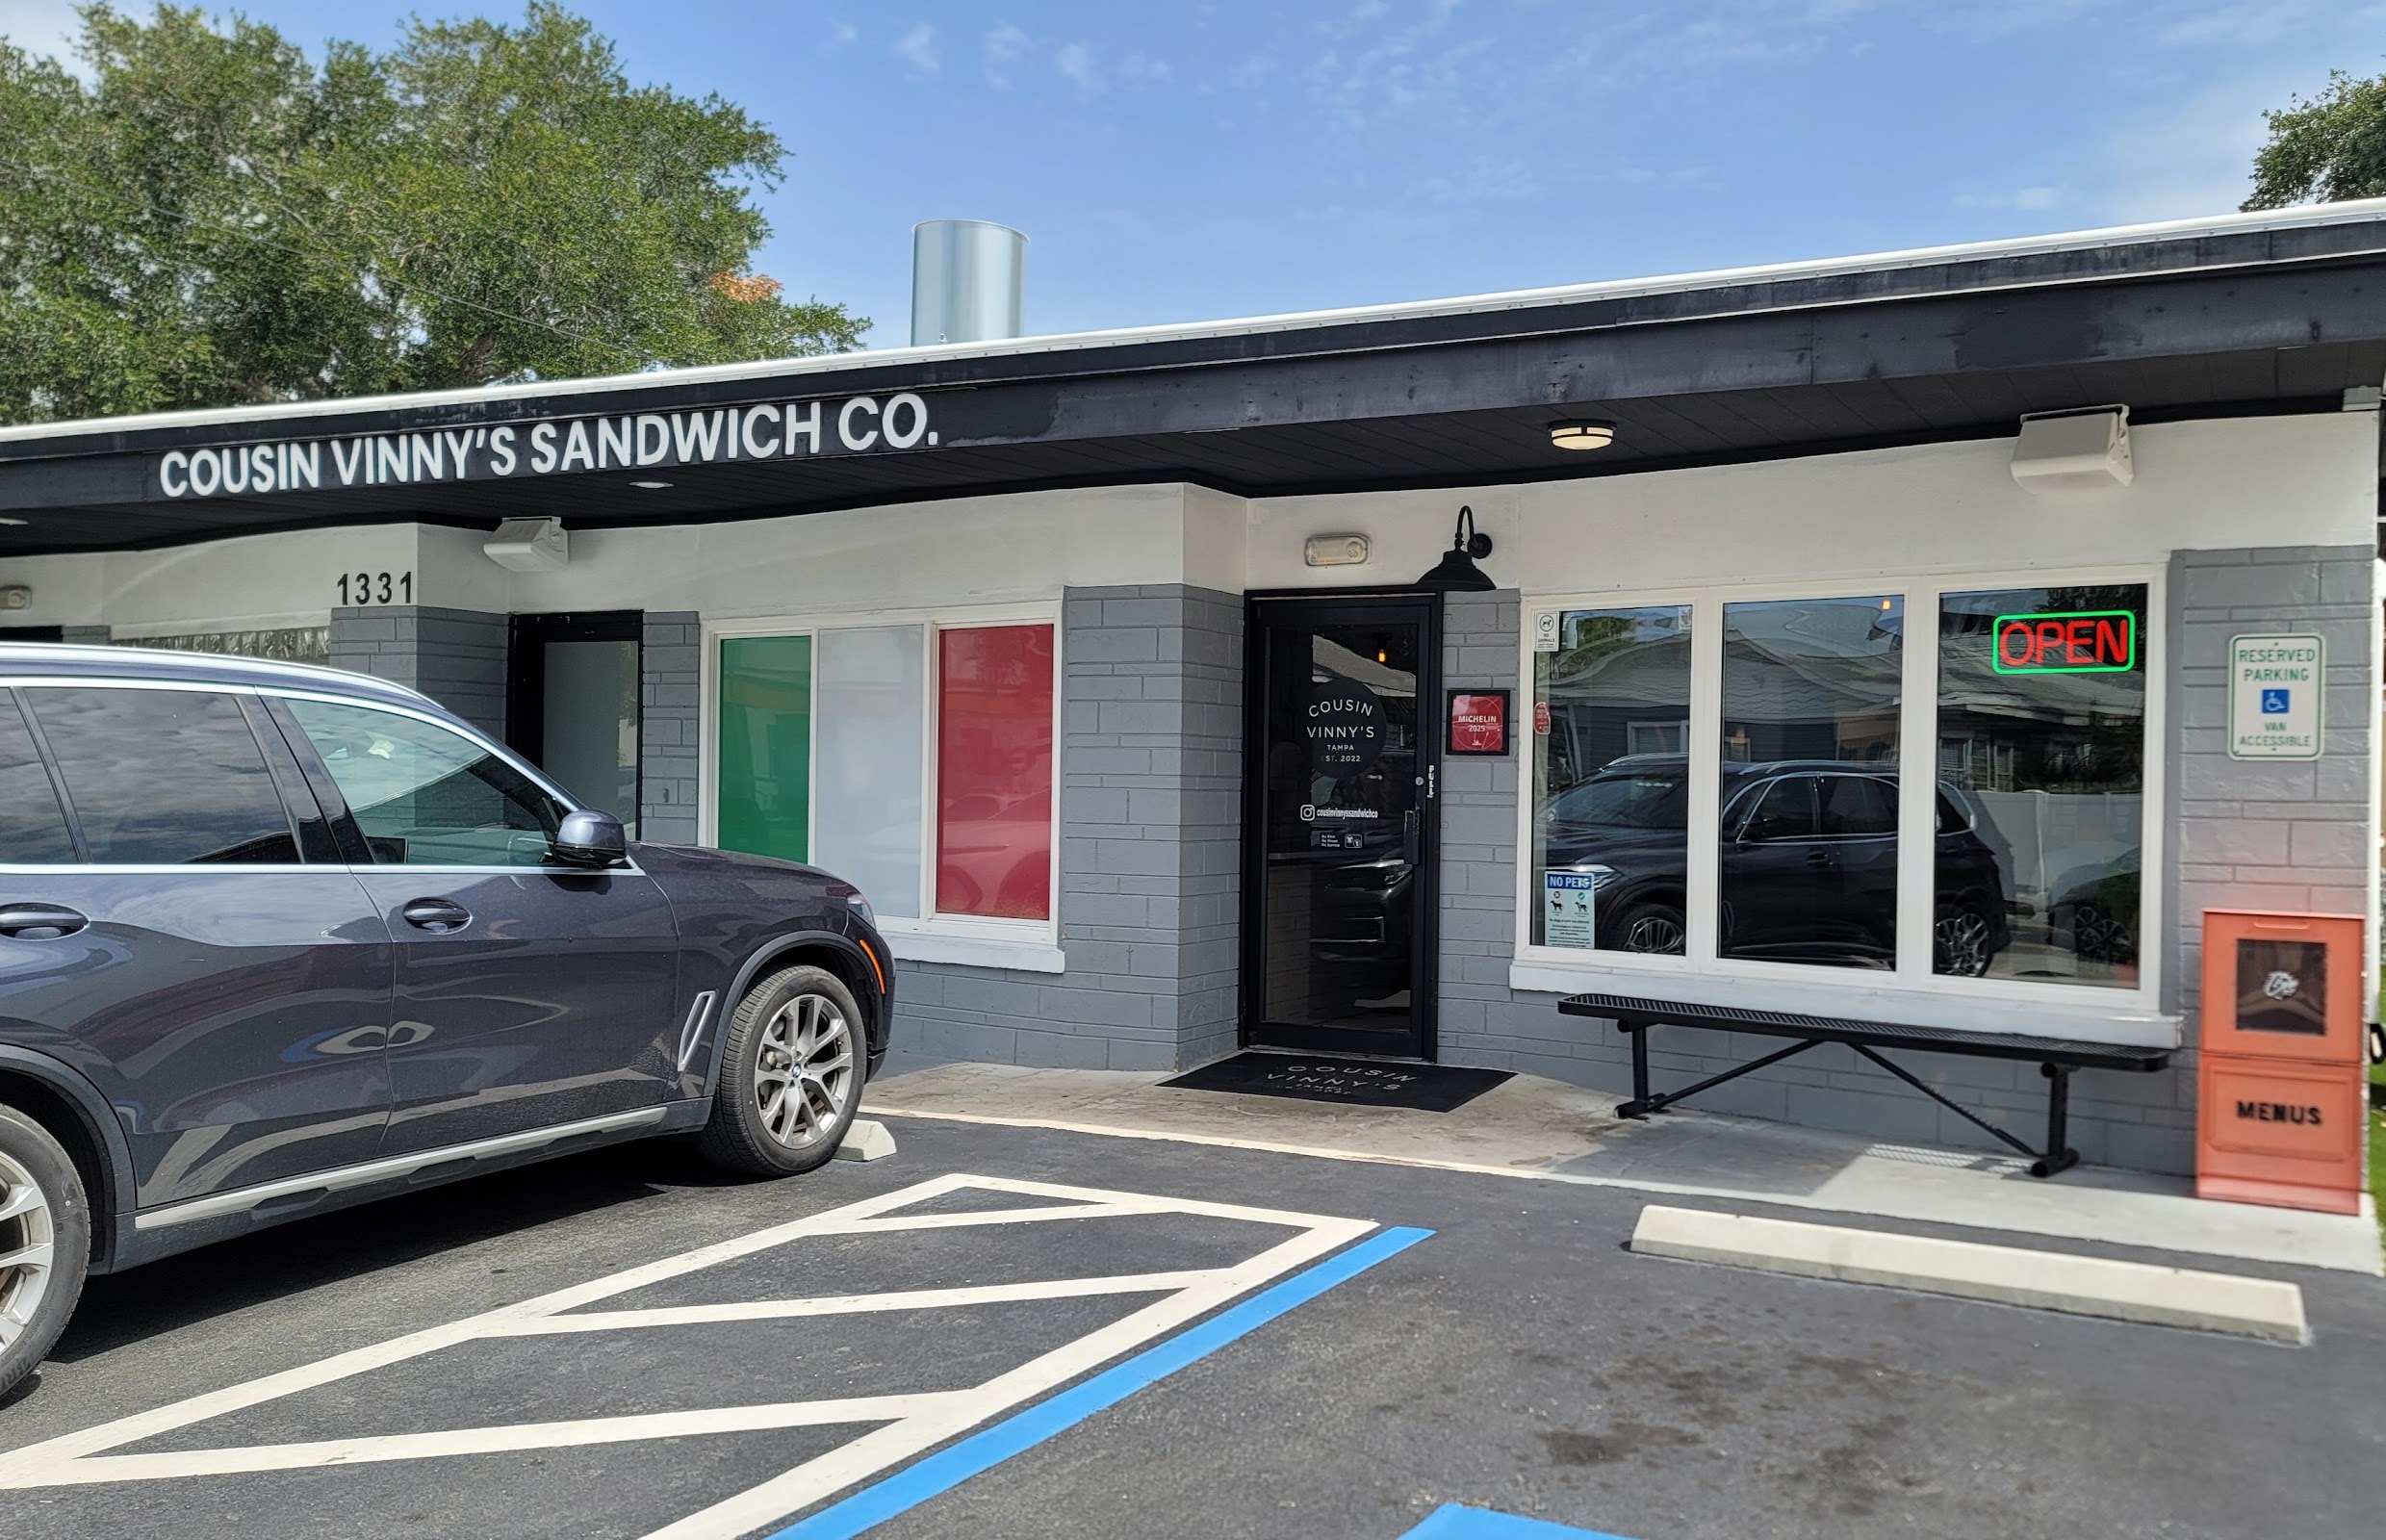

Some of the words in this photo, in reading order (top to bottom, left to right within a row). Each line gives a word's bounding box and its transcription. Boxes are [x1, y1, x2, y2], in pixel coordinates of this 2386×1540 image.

[160, 441, 320, 498] COUSIN
[330, 426, 516, 486] VINNY'S
[530, 401, 822, 475] SANDWICH
[837, 393, 939, 450] CO.
[337, 571, 412, 605] 1331
[1999, 619, 2128, 666] OPEN
[2239, 649, 2316, 662] RESERVED
[2244, 668, 2309, 681] PARKING
[1309, 699, 1373, 717] COUSIN
[1306, 726, 1374, 738] VINNY'S
[2264, 722, 2286, 732] VAN
[2240, 735, 2311, 746] ACCESSIBLE
[1550, 876, 1563, 886] NO
[1566, 877, 1590, 888] PETS
[2237, 1101, 2322, 1125] MENUS
